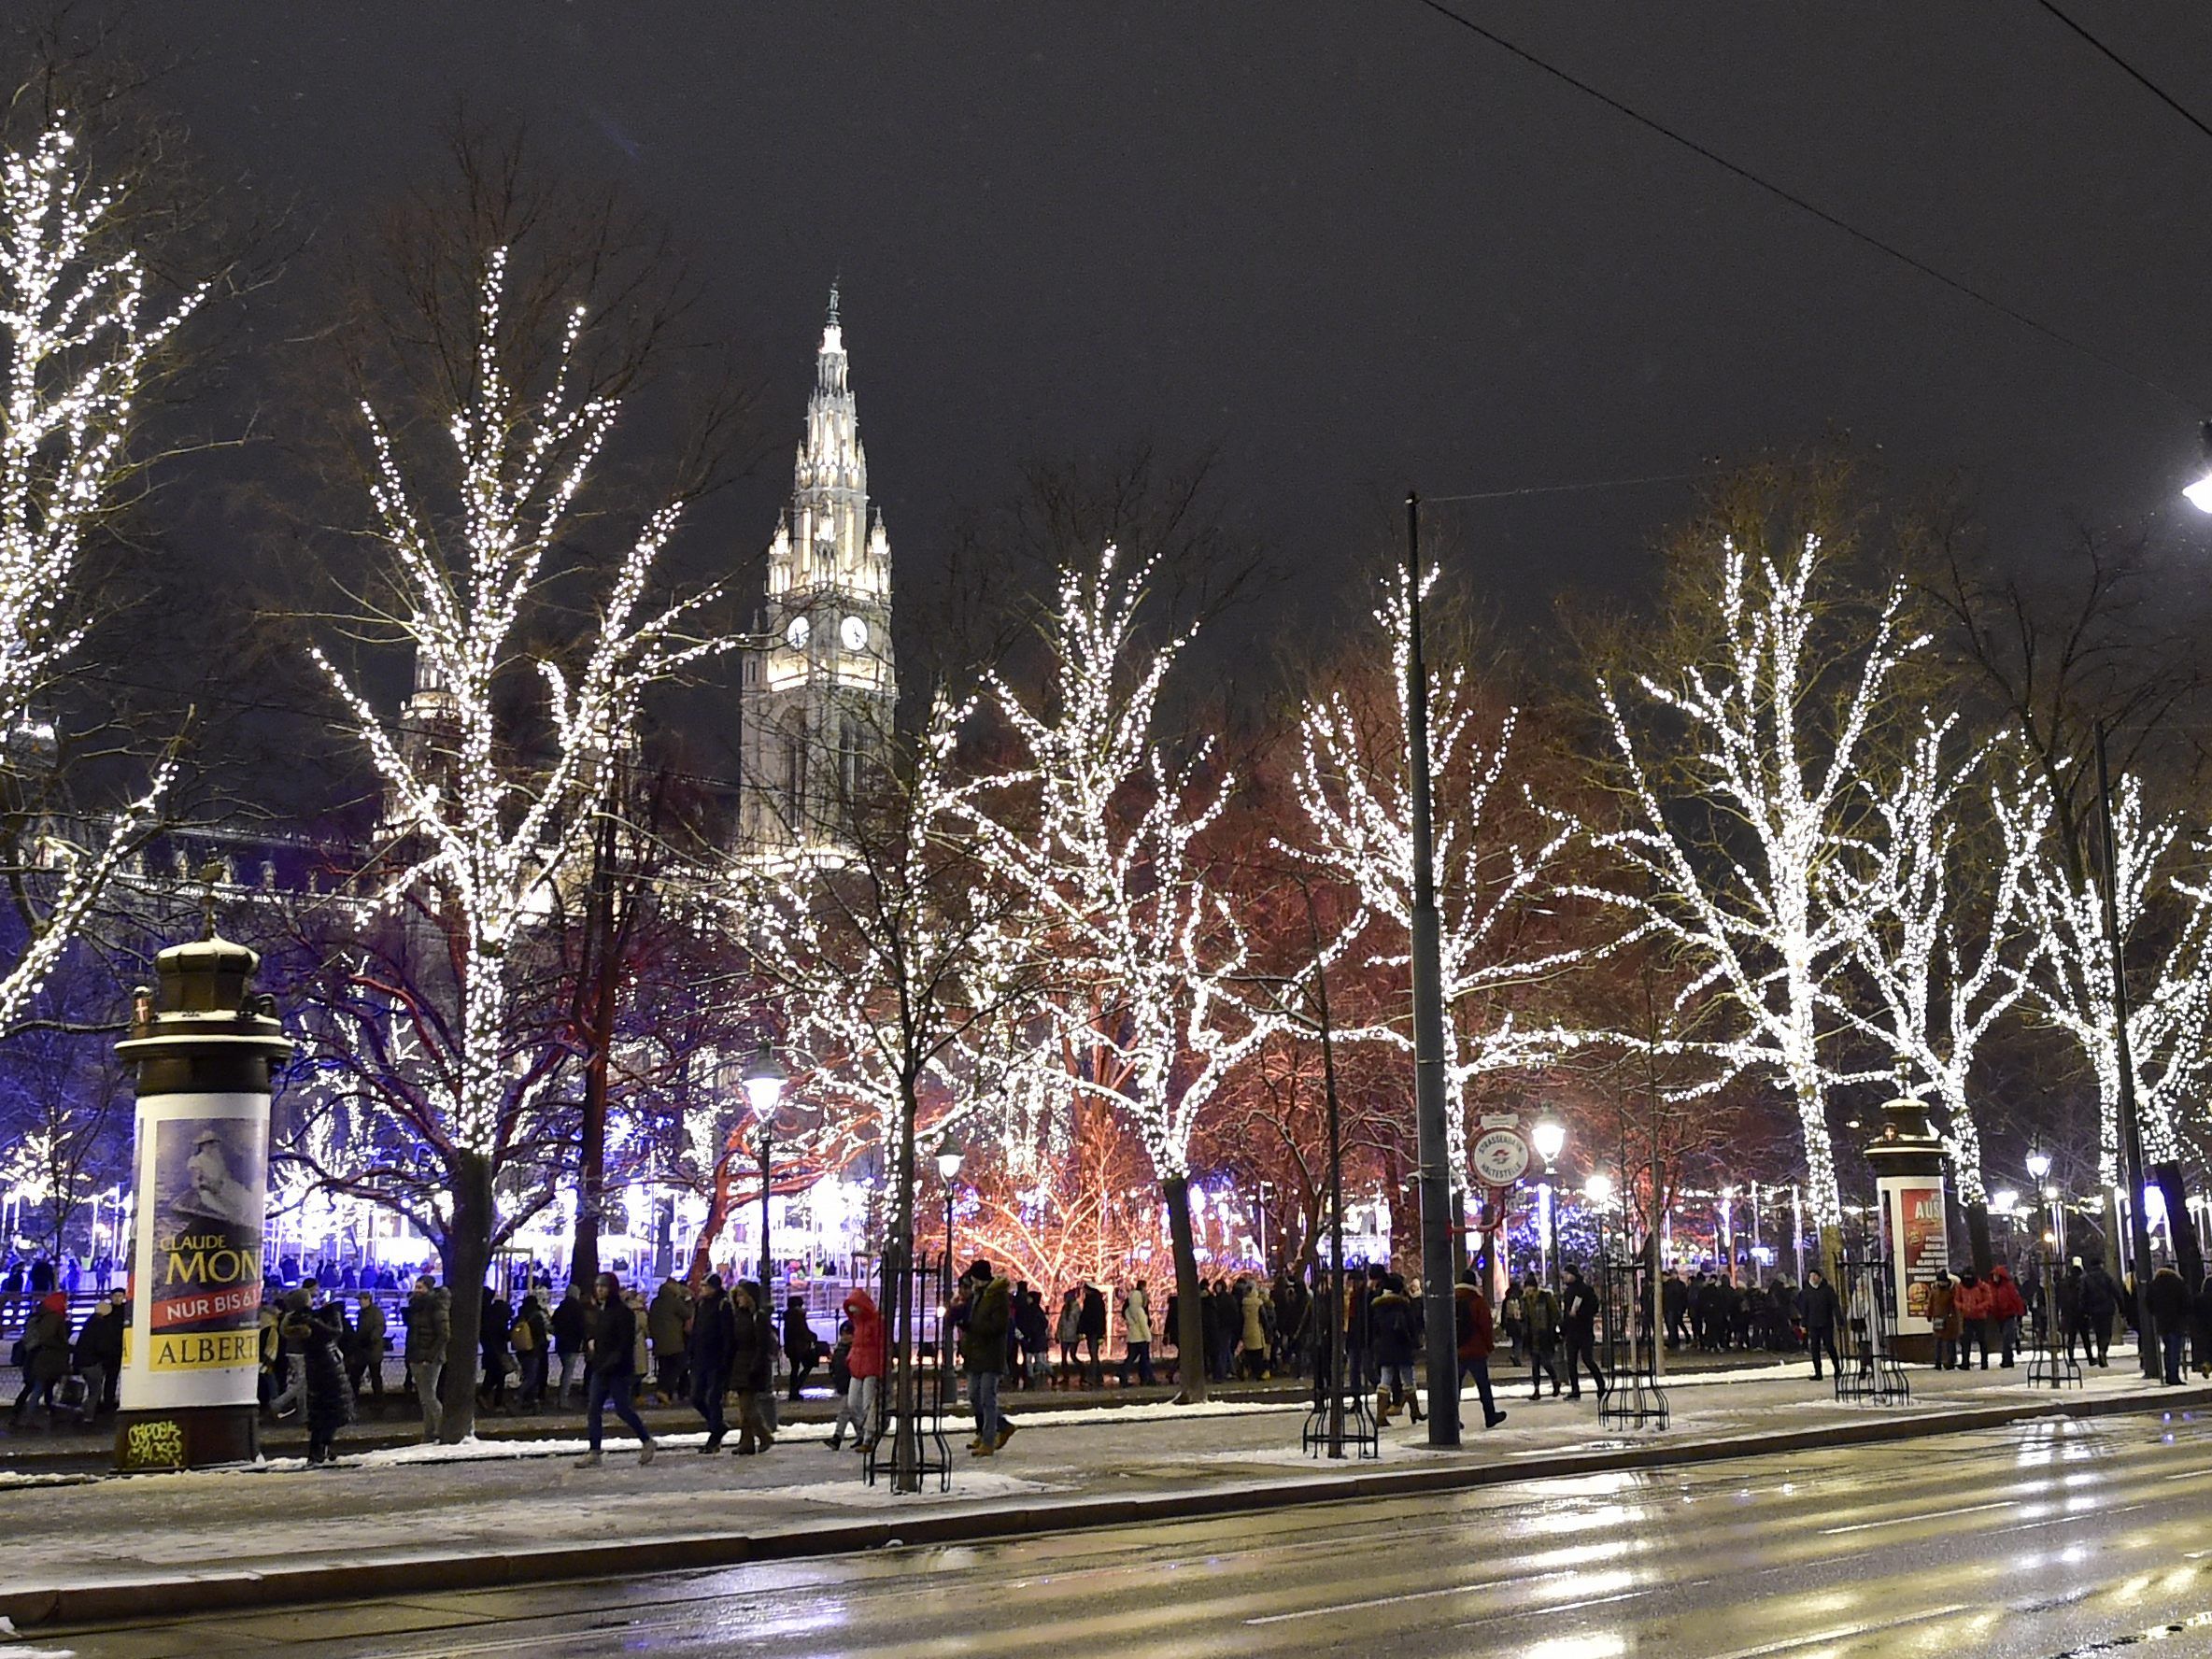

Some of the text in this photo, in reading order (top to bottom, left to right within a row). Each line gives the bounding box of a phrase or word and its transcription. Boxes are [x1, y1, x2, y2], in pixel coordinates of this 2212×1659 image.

[1481, 1161, 1522, 1179] HALTESTELLE
[160, 1234, 227, 1252] CLAUDE
[165, 1249, 259, 1285] MON
[167, 1299, 209, 1321] NUR
[214, 1294, 241, 1313] BIS
